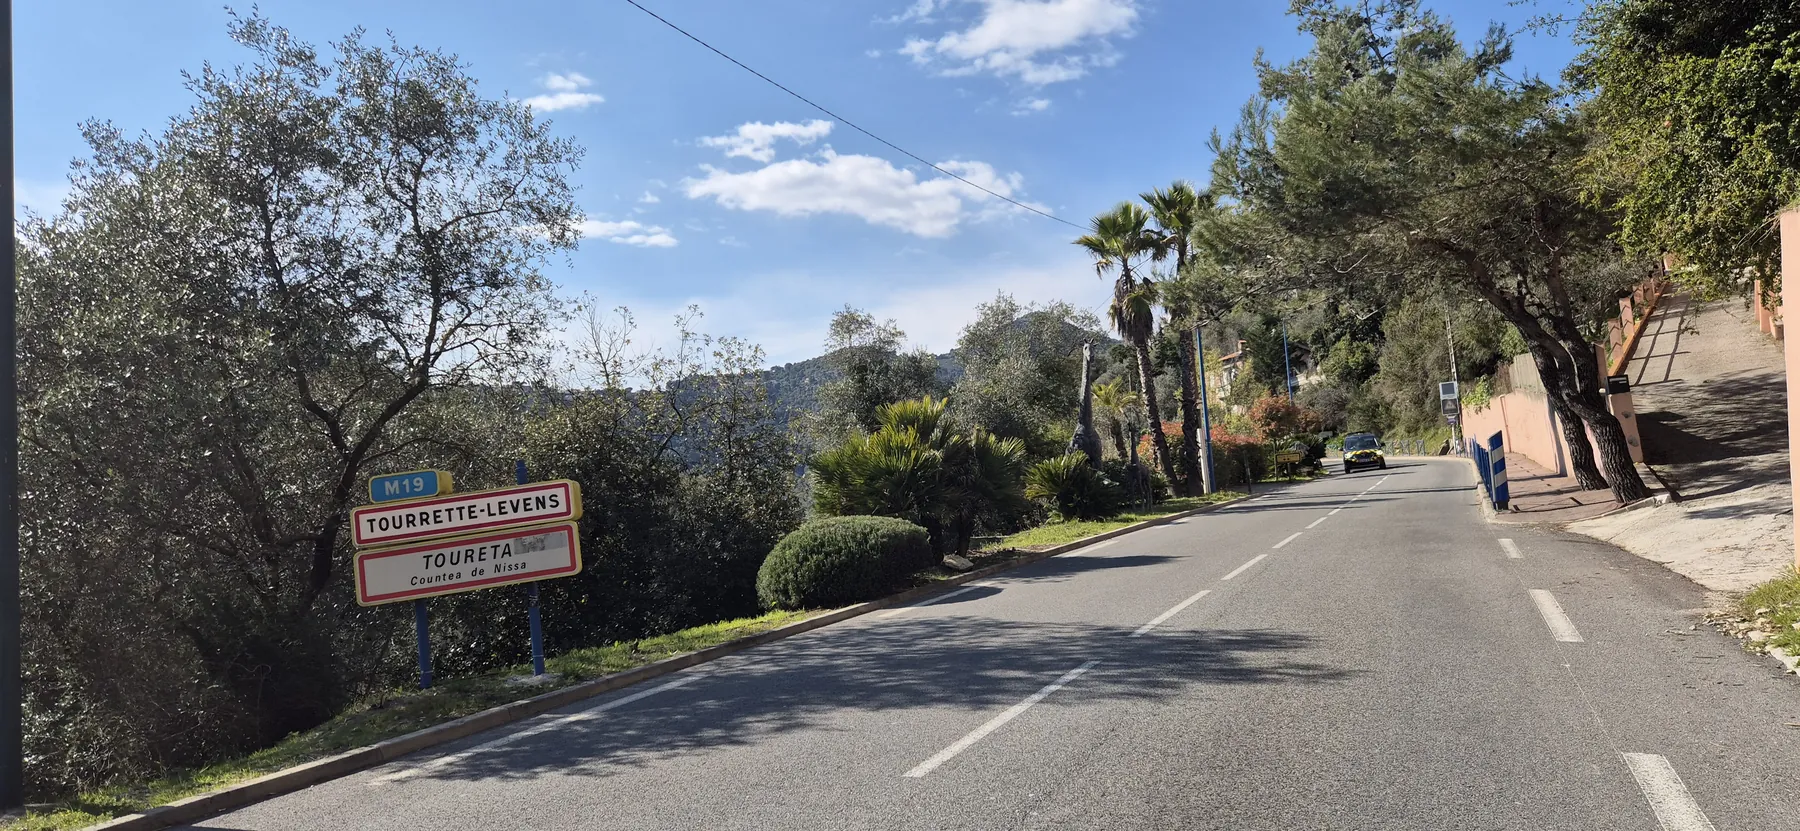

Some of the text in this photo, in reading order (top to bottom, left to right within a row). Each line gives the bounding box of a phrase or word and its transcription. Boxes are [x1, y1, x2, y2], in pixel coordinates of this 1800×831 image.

[385, 477, 424, 496] M19
[367, 494, 560, 532] TOURRETTE-LEVENS
[423, 543, 512, 570] TOURETA
[410, 561, 527, 586] Countea de Nissa
